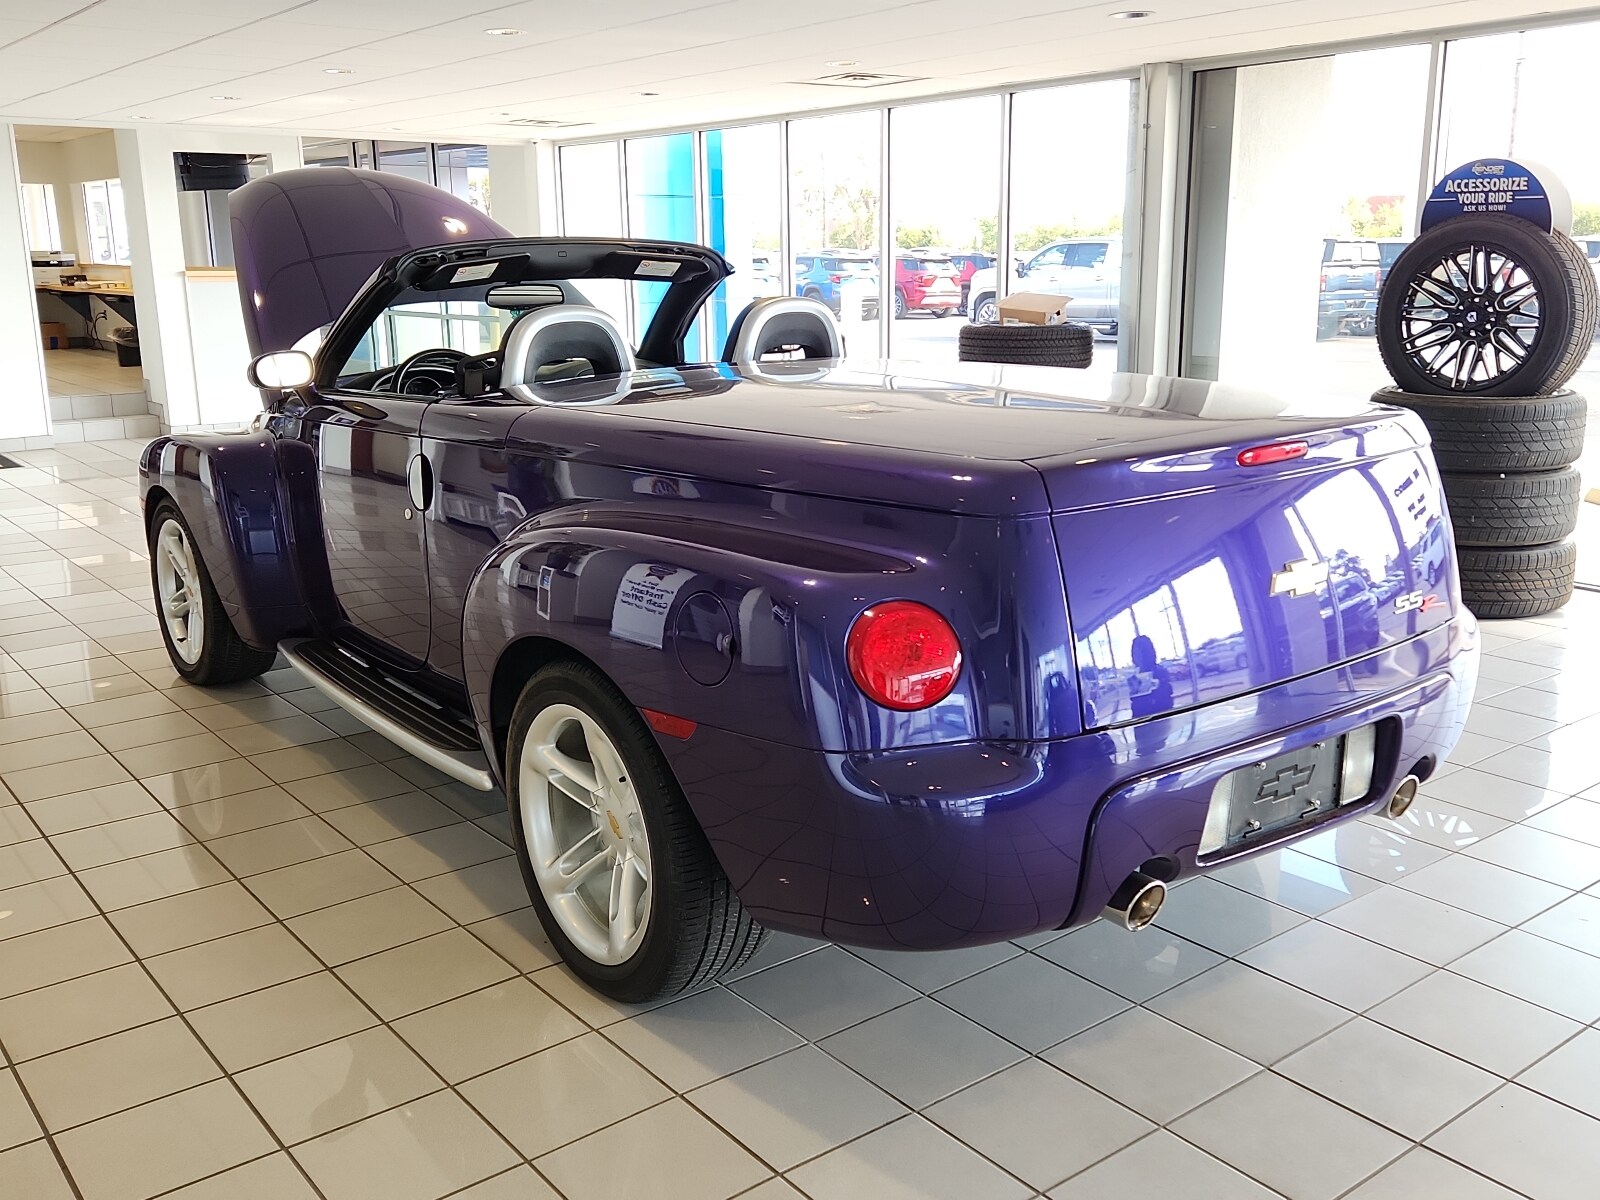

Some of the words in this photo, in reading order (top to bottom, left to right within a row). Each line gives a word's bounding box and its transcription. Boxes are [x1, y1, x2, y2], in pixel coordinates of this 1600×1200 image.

[1445, 177, 1528, 192] ACCESSORIZE
[1457, 193, 1485, 204] YOUR
[1488, 192, 1513, 203] RIDE
[1393, 590, 1447, 614] SSR
